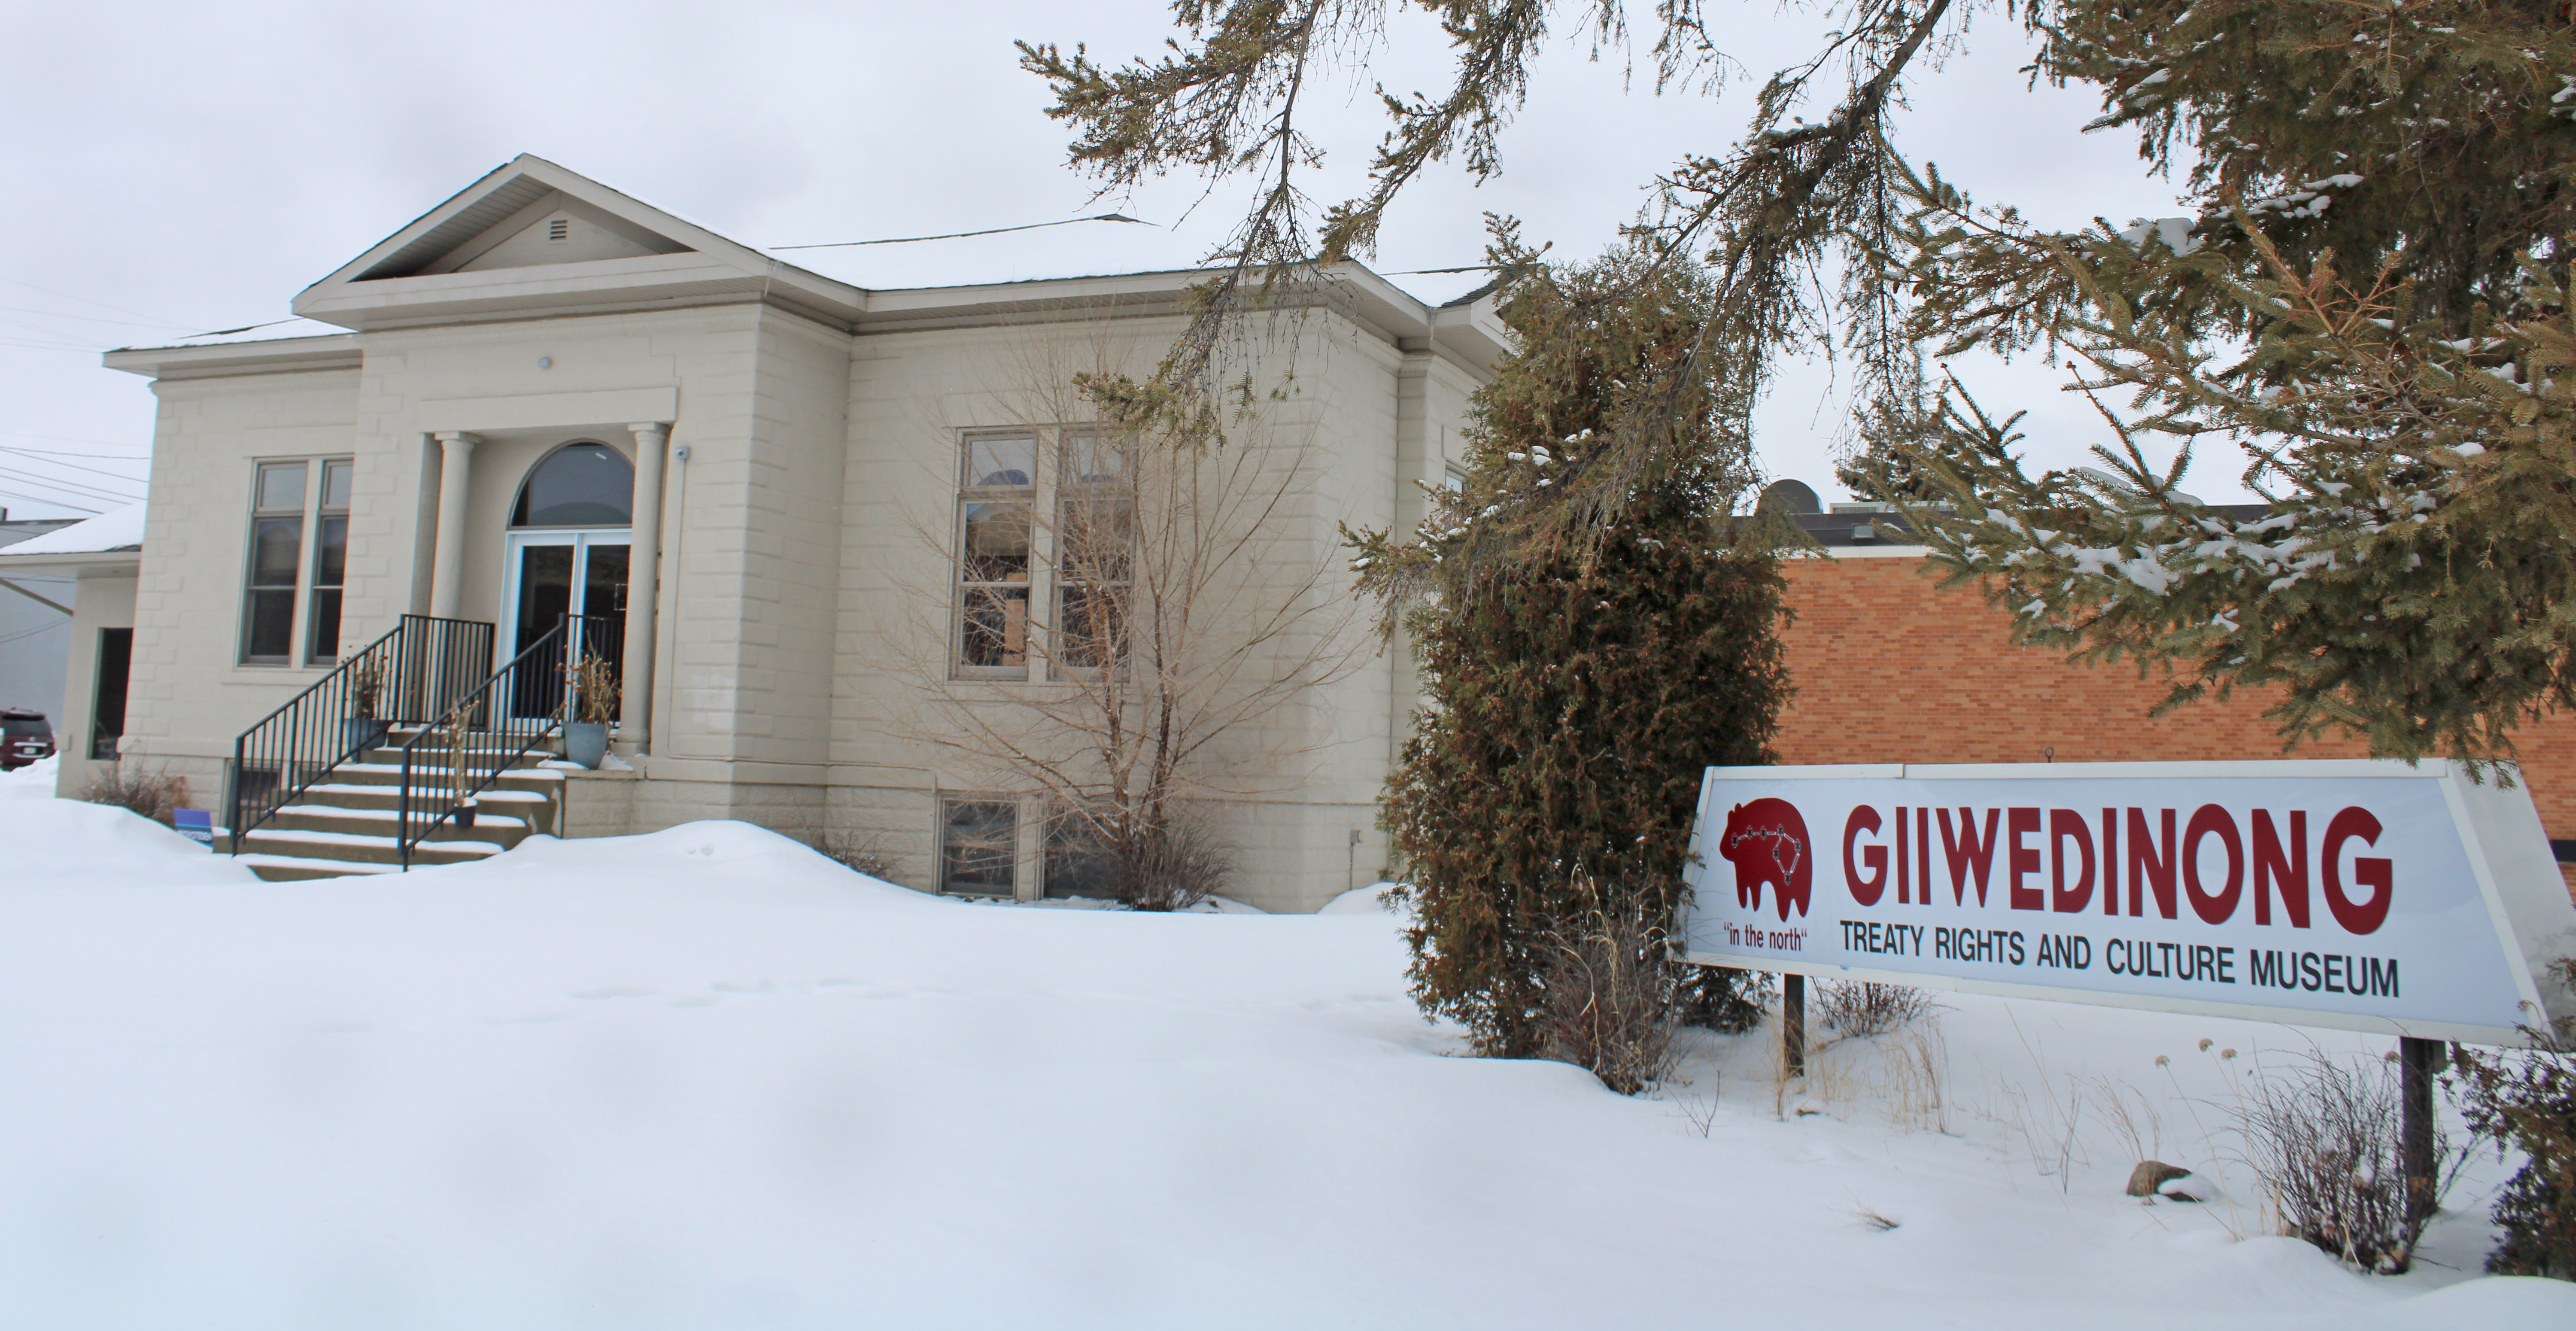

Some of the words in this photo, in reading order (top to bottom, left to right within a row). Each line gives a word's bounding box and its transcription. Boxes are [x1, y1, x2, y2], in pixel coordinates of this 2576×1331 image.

[1843, 804, 2392, 935] GIIWEDINONG
[1745, 924, 1764, 948] the
[1840, 920, 1924, 956] TREATY
[1936, 927, 2024, 965] RIGHTS
[2037, 934, 2090, 969] AND
[2106, 939, 2235, 983] CULTURE
[2251, 949, 2398, 997] MUSEUM
